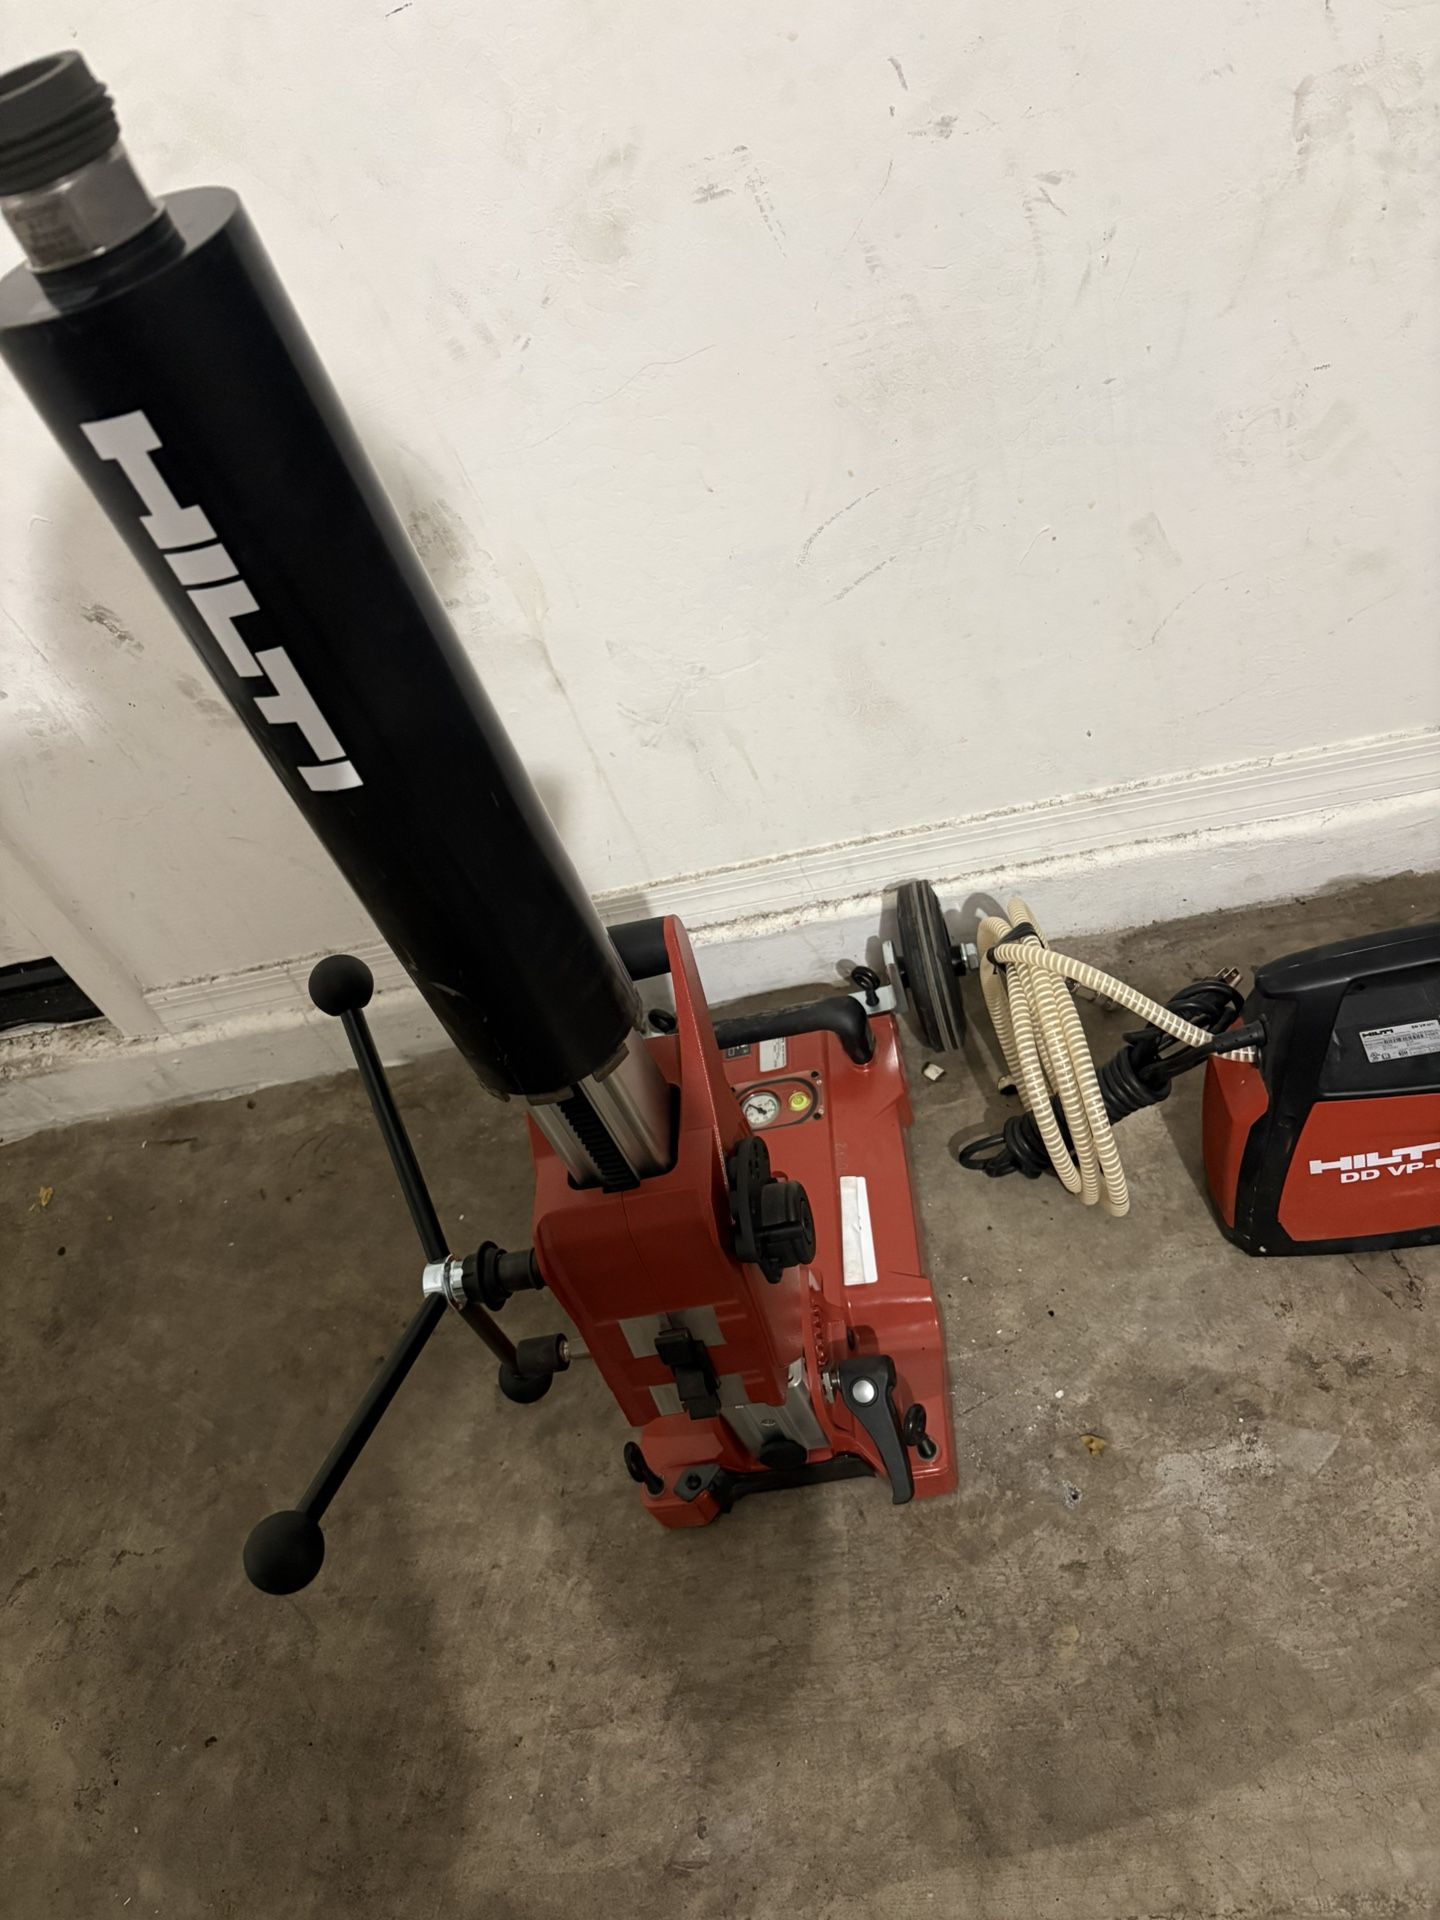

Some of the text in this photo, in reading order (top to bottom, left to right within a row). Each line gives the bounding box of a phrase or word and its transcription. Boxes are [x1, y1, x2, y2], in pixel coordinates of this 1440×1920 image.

[80, 409, 364, 792] HILTI
[1362, 1028, 1394, 1038] HILTI
[1309, 1141, 1440, 1175] HILT
[1340, 1169, 1380, 1184] DD
